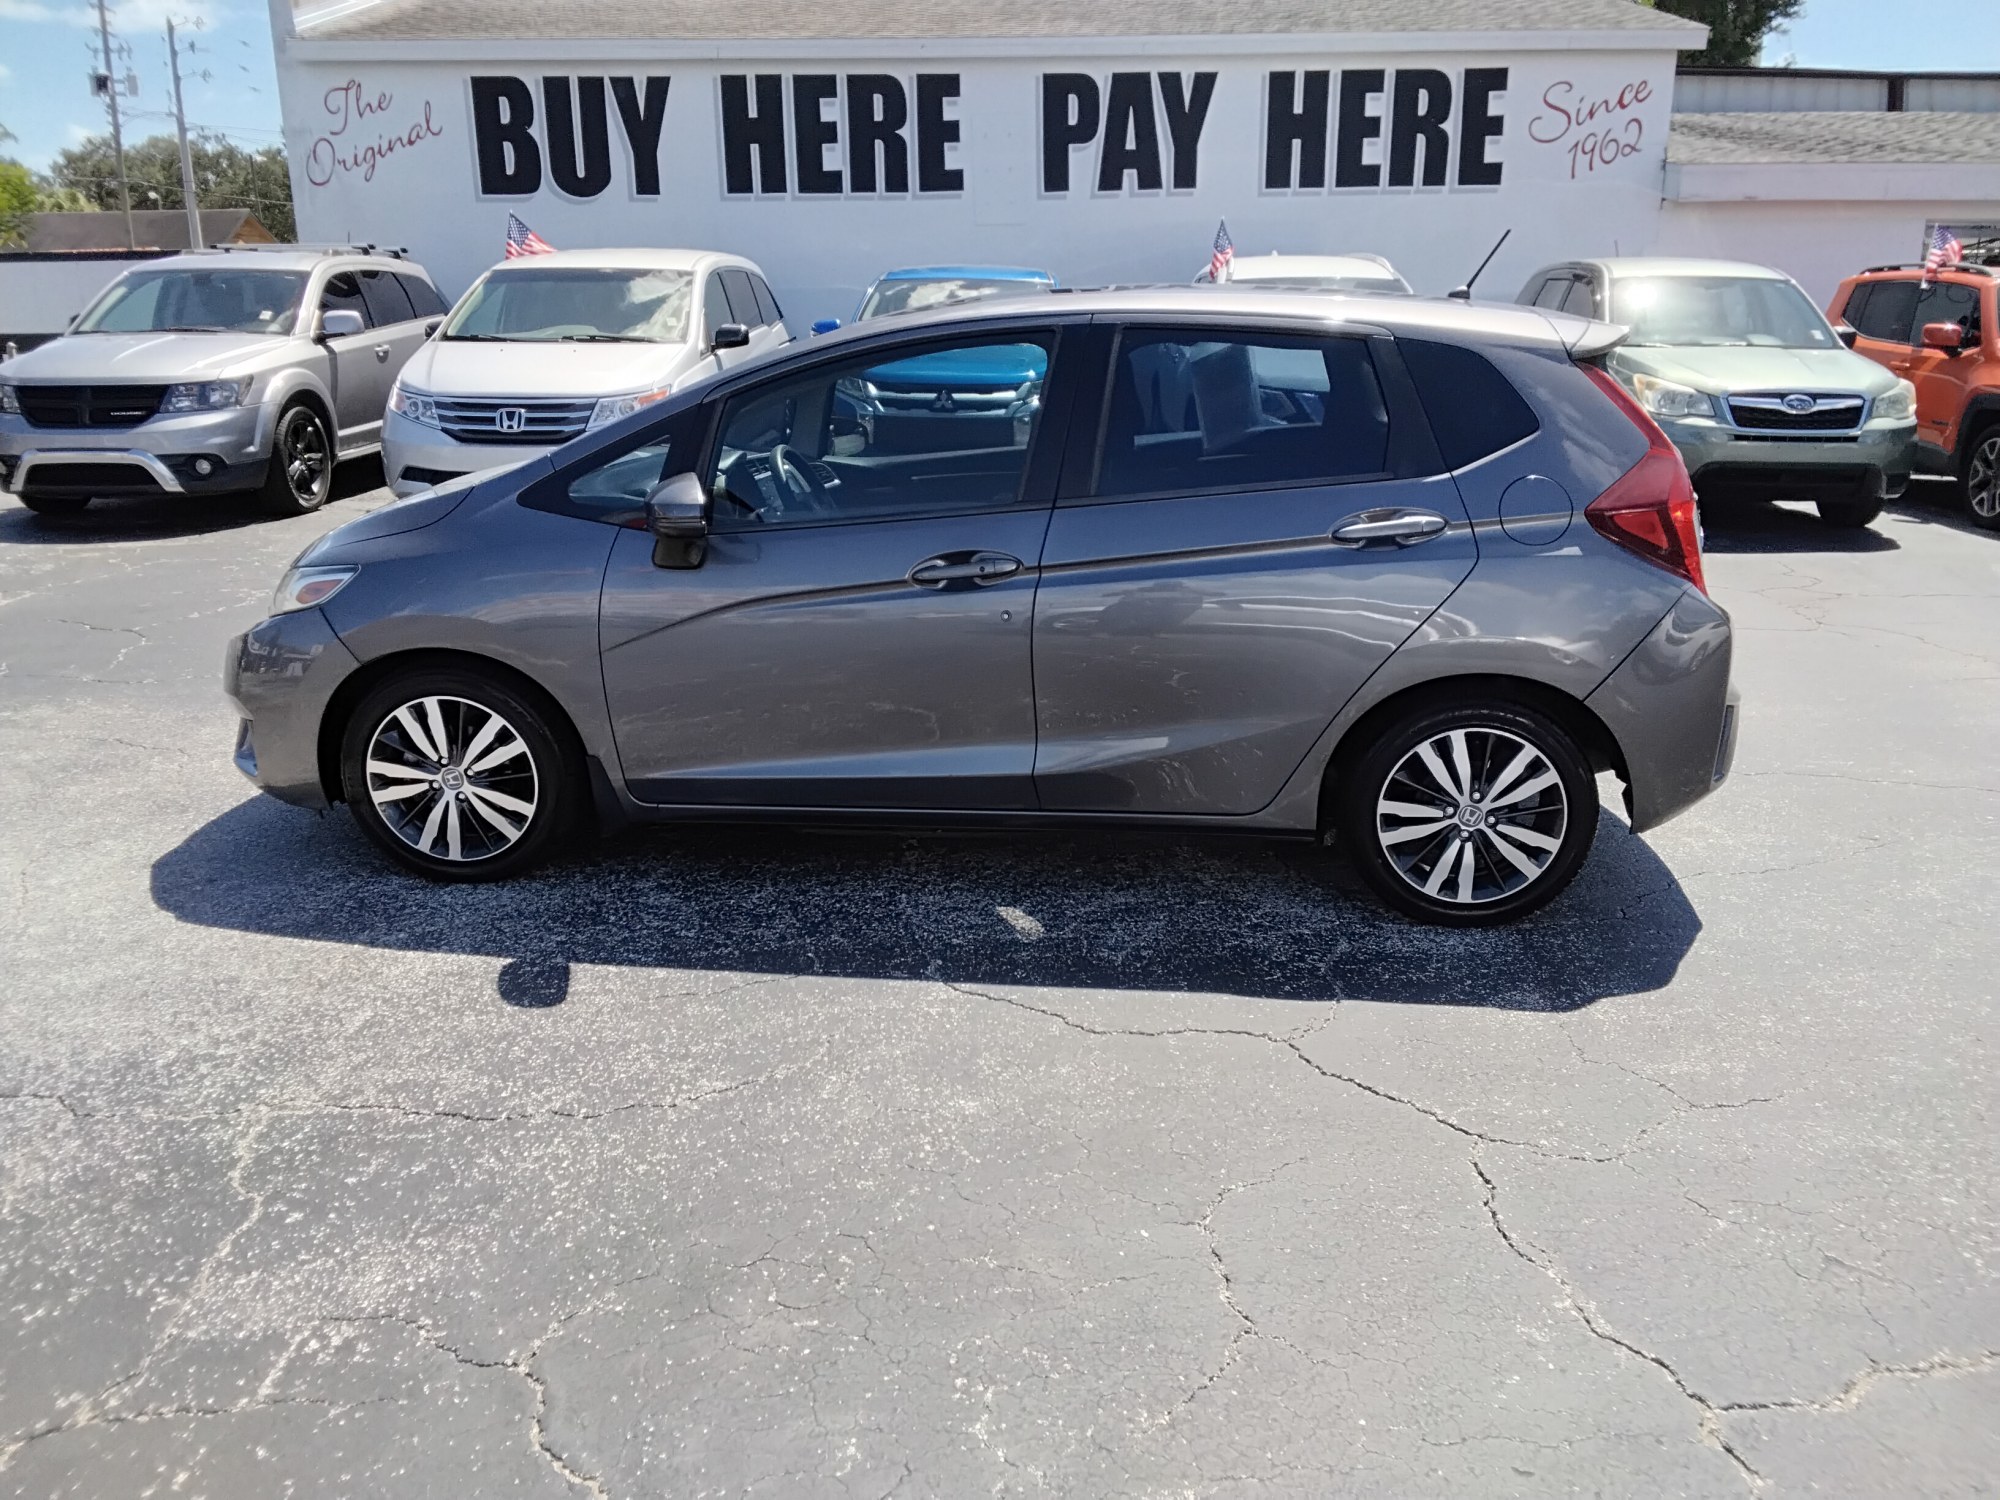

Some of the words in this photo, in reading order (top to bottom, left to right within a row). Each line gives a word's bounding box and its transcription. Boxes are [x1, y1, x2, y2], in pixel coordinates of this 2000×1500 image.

[324, 79, 393, 136] The
[469, 76, 671, 198] BUY
[719, 73, 964, 194] HERE
[1041, 71, 1218, 193] PAY
[1264, 67, 1509, 189] HERE
[1528, 80, 1653, 143] Since
[306, 100, 443, 186] Original
[1567, 117, 1642, 180] 1962
